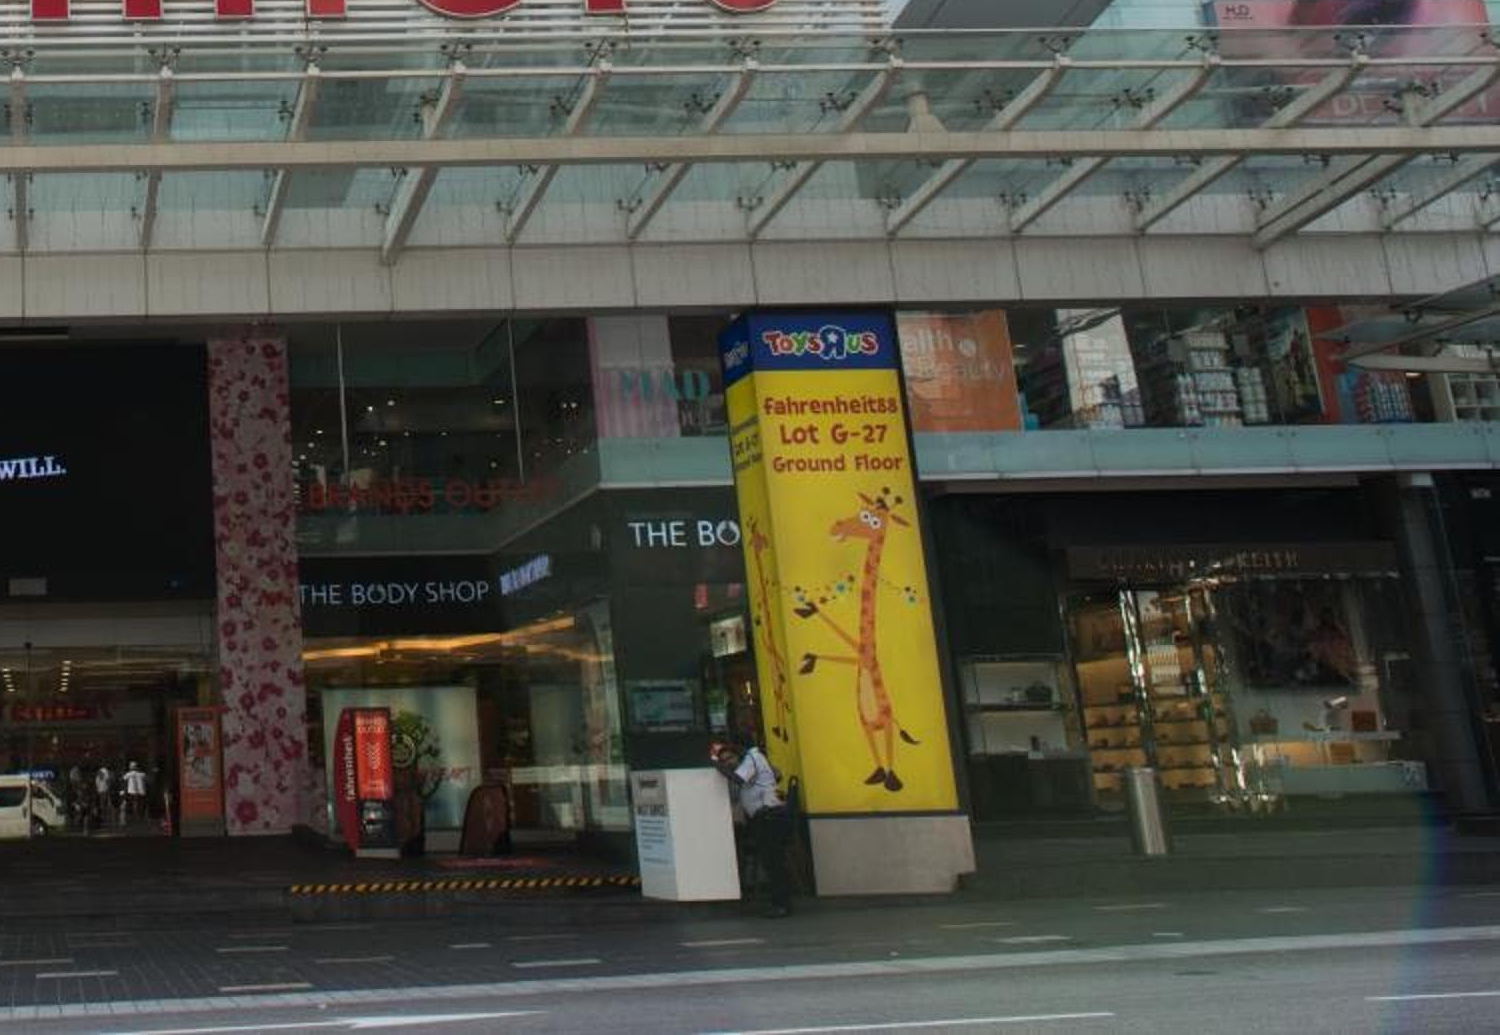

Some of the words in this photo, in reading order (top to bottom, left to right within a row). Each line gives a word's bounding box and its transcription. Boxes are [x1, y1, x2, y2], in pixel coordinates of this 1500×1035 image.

[763, 396, 898, 416] fahrenheit88
[780, 423, 819, 445] Lot
[830, 422, 888, 445] G-27
[772, 453, 845, 473] Ground
[855, 453, 904, 470] Floor
[628, 520, 687, 548] THE
[300, 584, 340, 605] THE
[352, 583, 419, 605] BODY
[426, 580, 490, 603] SHOP
